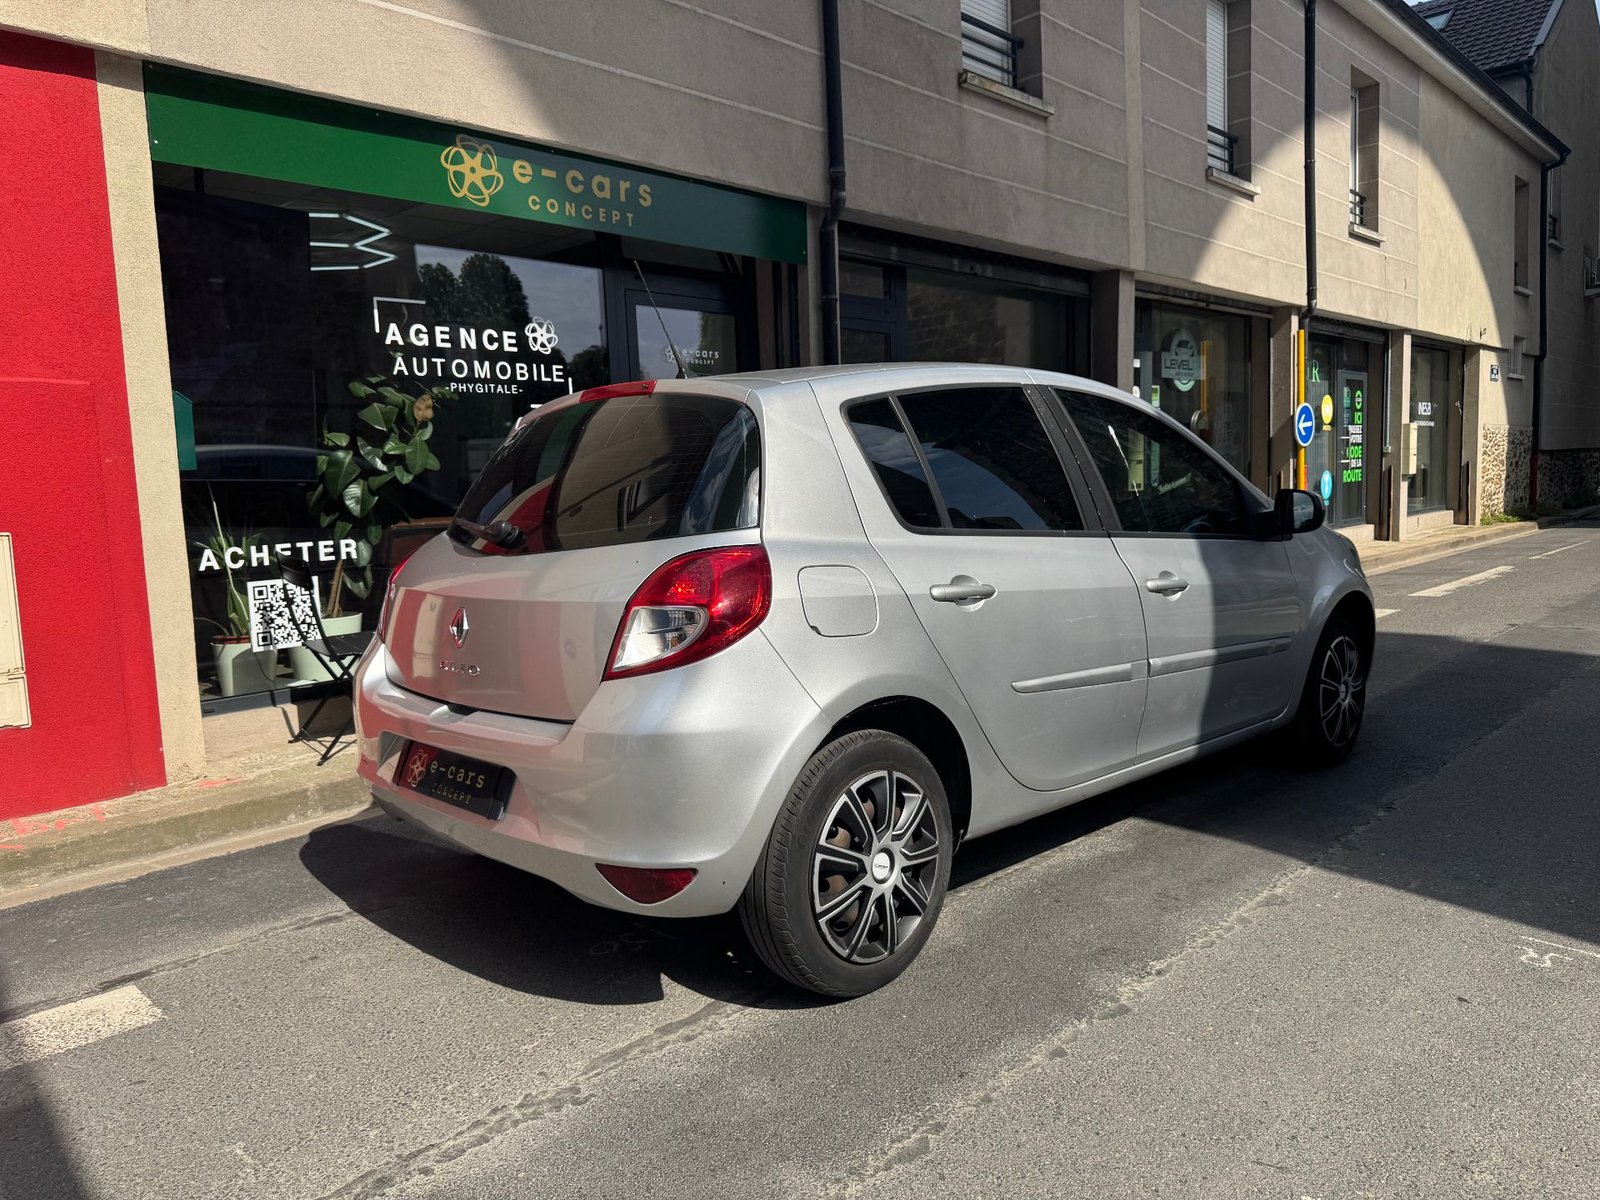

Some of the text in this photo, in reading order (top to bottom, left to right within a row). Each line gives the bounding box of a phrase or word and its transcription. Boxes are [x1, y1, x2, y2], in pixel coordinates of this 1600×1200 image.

[512, 159, 652, 207] e-cars
[528, 195, 634, 227] CONCEPT
[385, 323, 518, 352] AGENCE
[682, 349, 719, 358] e-cars
[1164, 358, 1193, 370] LEVEL
[393, 356, 565, 383] AUTOMOBILE
[1343, 469, 1362, 483] ROUTE
[430, 760, 485, 788] e-cars
[432, 783, 472, 804] CONCEPT
